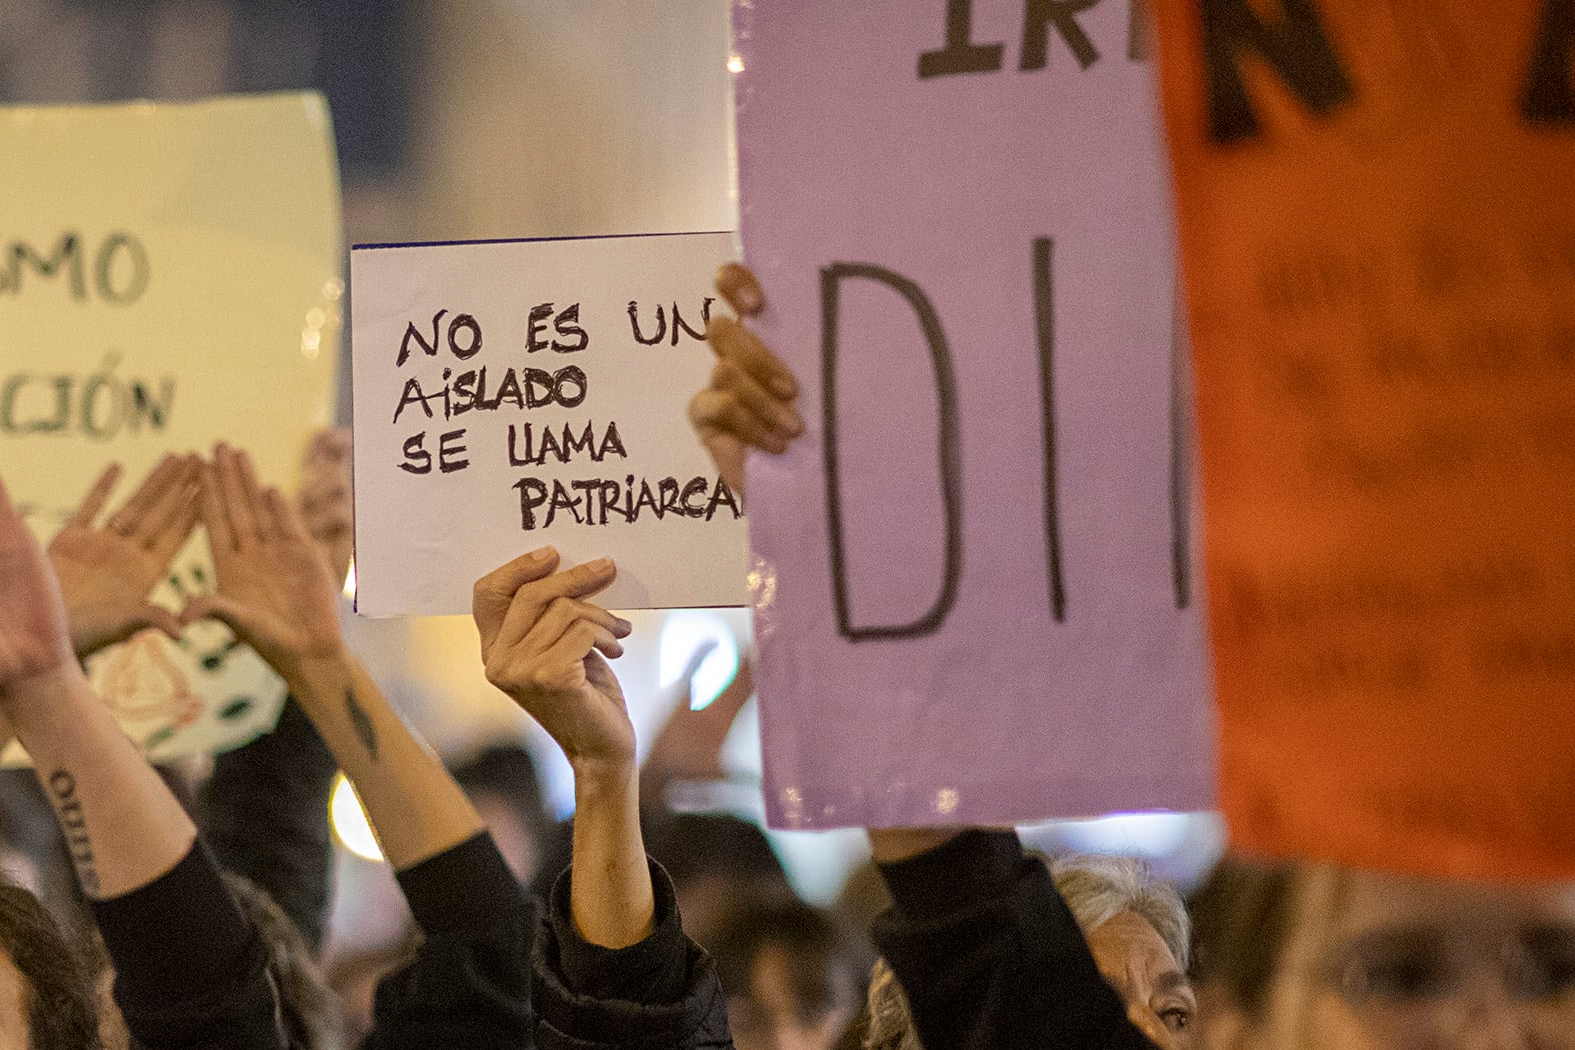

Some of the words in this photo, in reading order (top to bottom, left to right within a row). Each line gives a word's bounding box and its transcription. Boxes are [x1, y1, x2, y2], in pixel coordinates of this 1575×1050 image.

[396, 308, 483, 367] NO
[525, 302, 588, 353] ES
[627, 297, 715, 346] UN
[396, 428, 470, 475] SE
[508, 420, 628, 467] LLAMA
[819, 236, 1193, 643] DI
